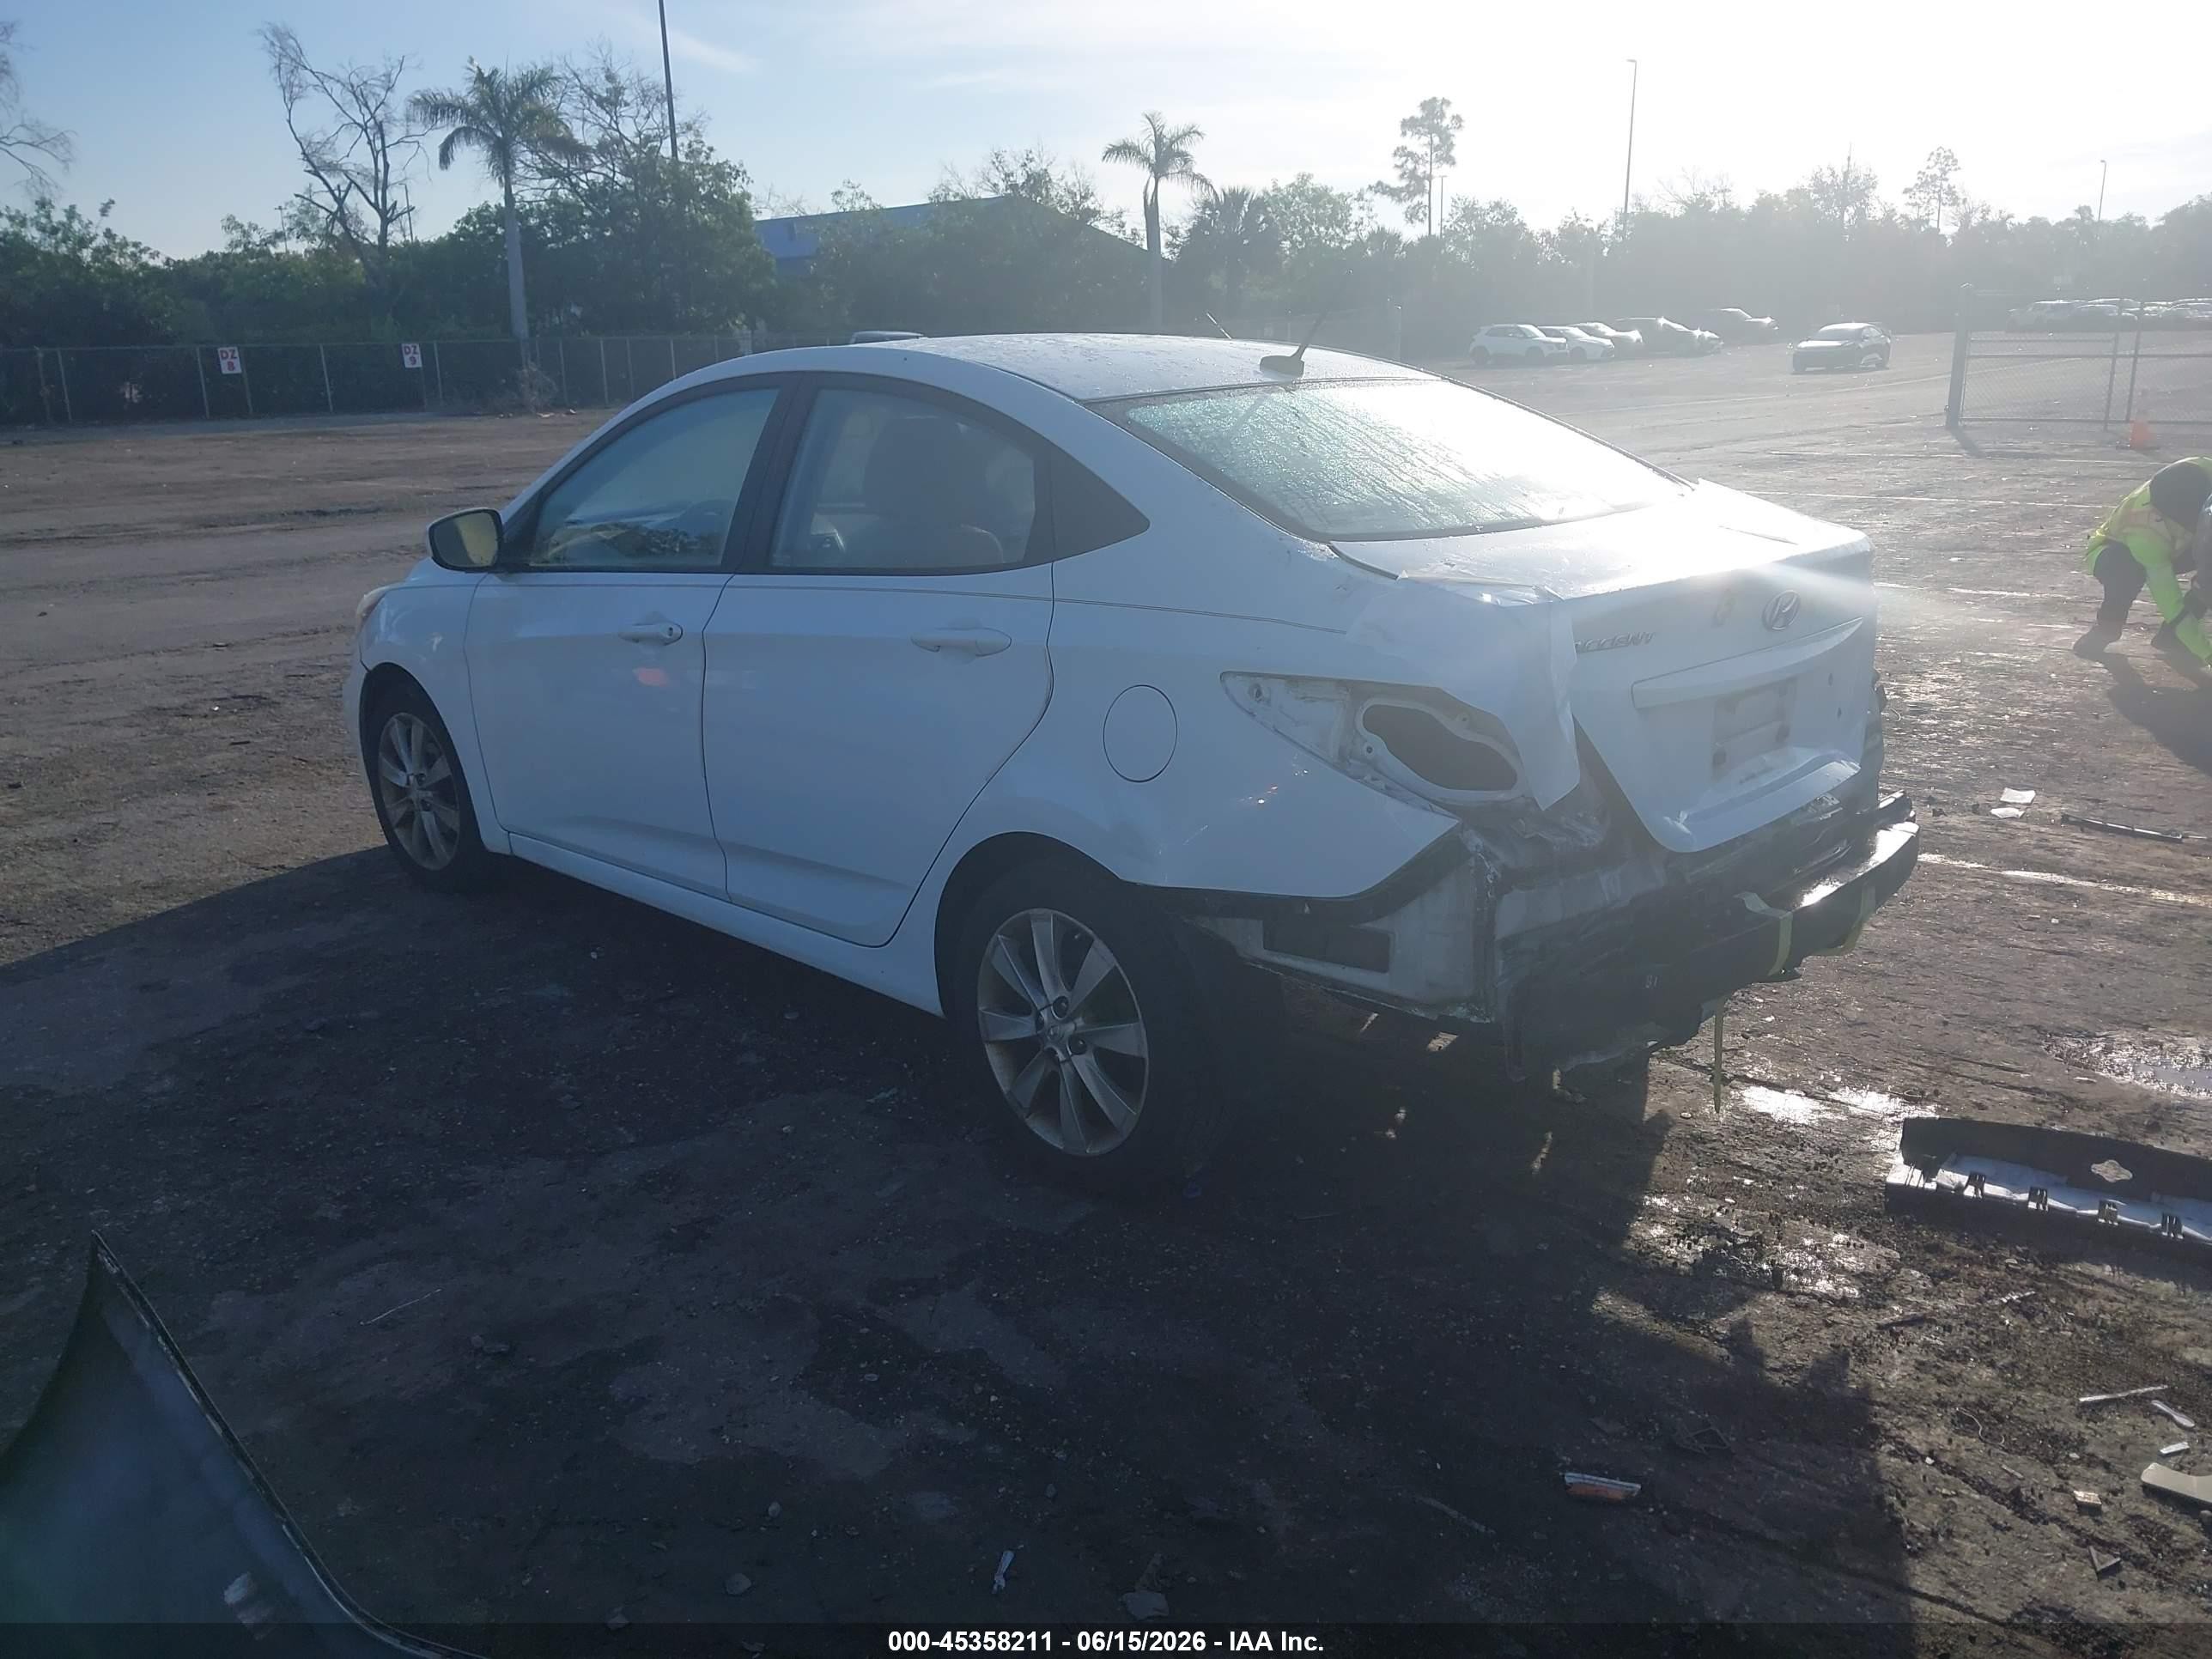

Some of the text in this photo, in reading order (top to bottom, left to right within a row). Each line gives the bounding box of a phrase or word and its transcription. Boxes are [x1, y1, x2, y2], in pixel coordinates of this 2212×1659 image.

[220, 349, 238, 360] DZ
[404, 344, 419, 356] DZ
[227, 361, 235, 371] 8
[410, 356, 417, 366] 9
